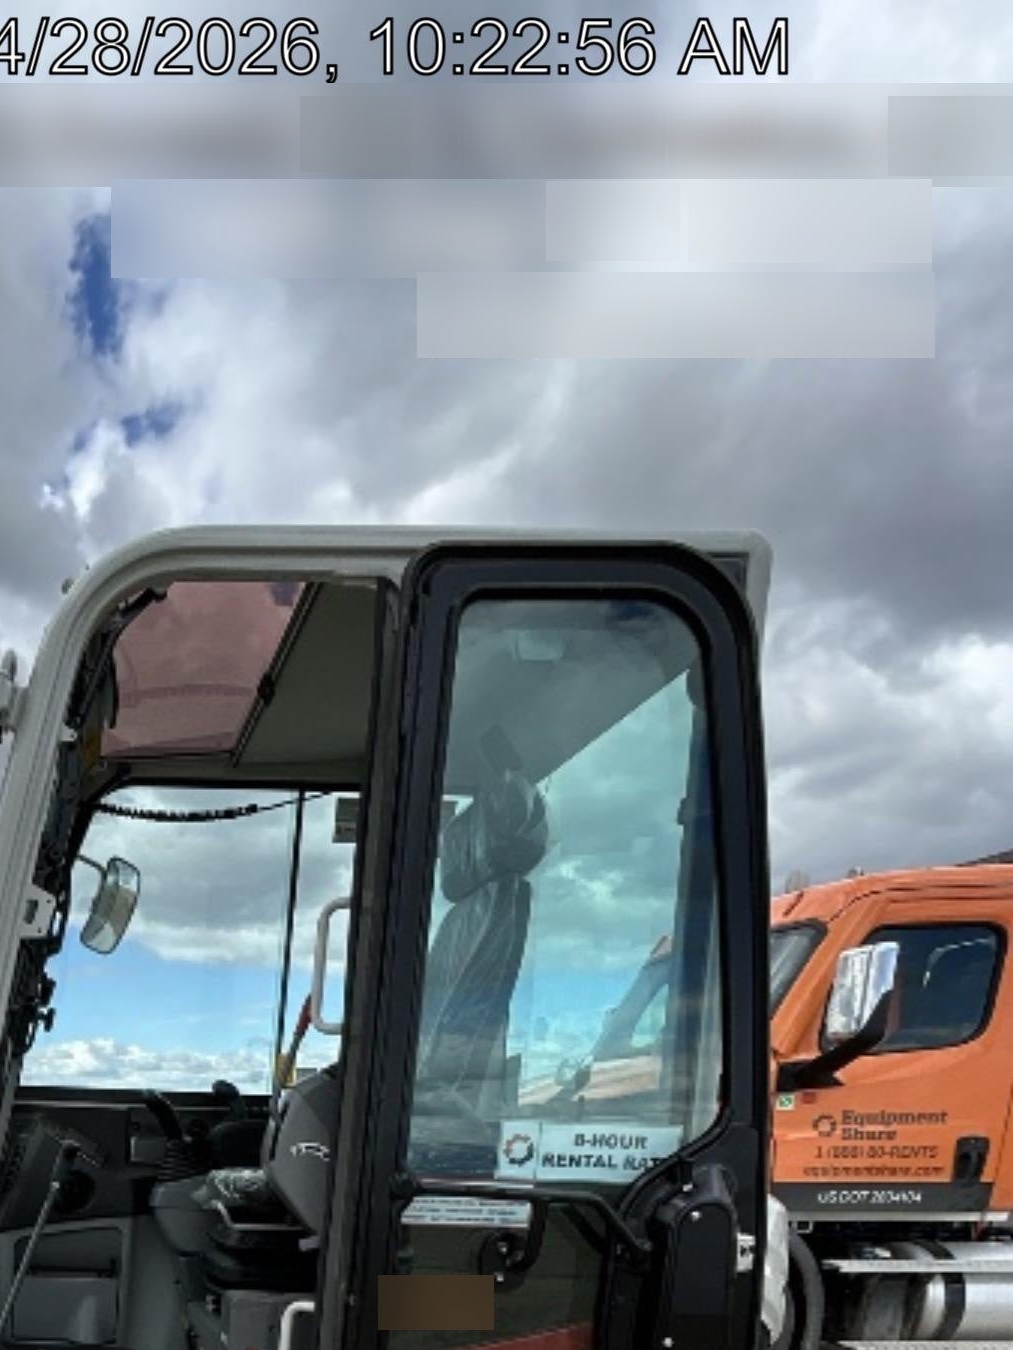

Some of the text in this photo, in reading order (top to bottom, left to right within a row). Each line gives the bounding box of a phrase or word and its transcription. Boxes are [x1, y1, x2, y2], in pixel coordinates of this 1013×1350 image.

[841, 1109, 948, 1127] Equipment
[574, 1133, 649, 1149] 8-HOUR
[841, 1127, 897, 1140] Share
[541, 1153, 670, 1171] RENTAL RAT
